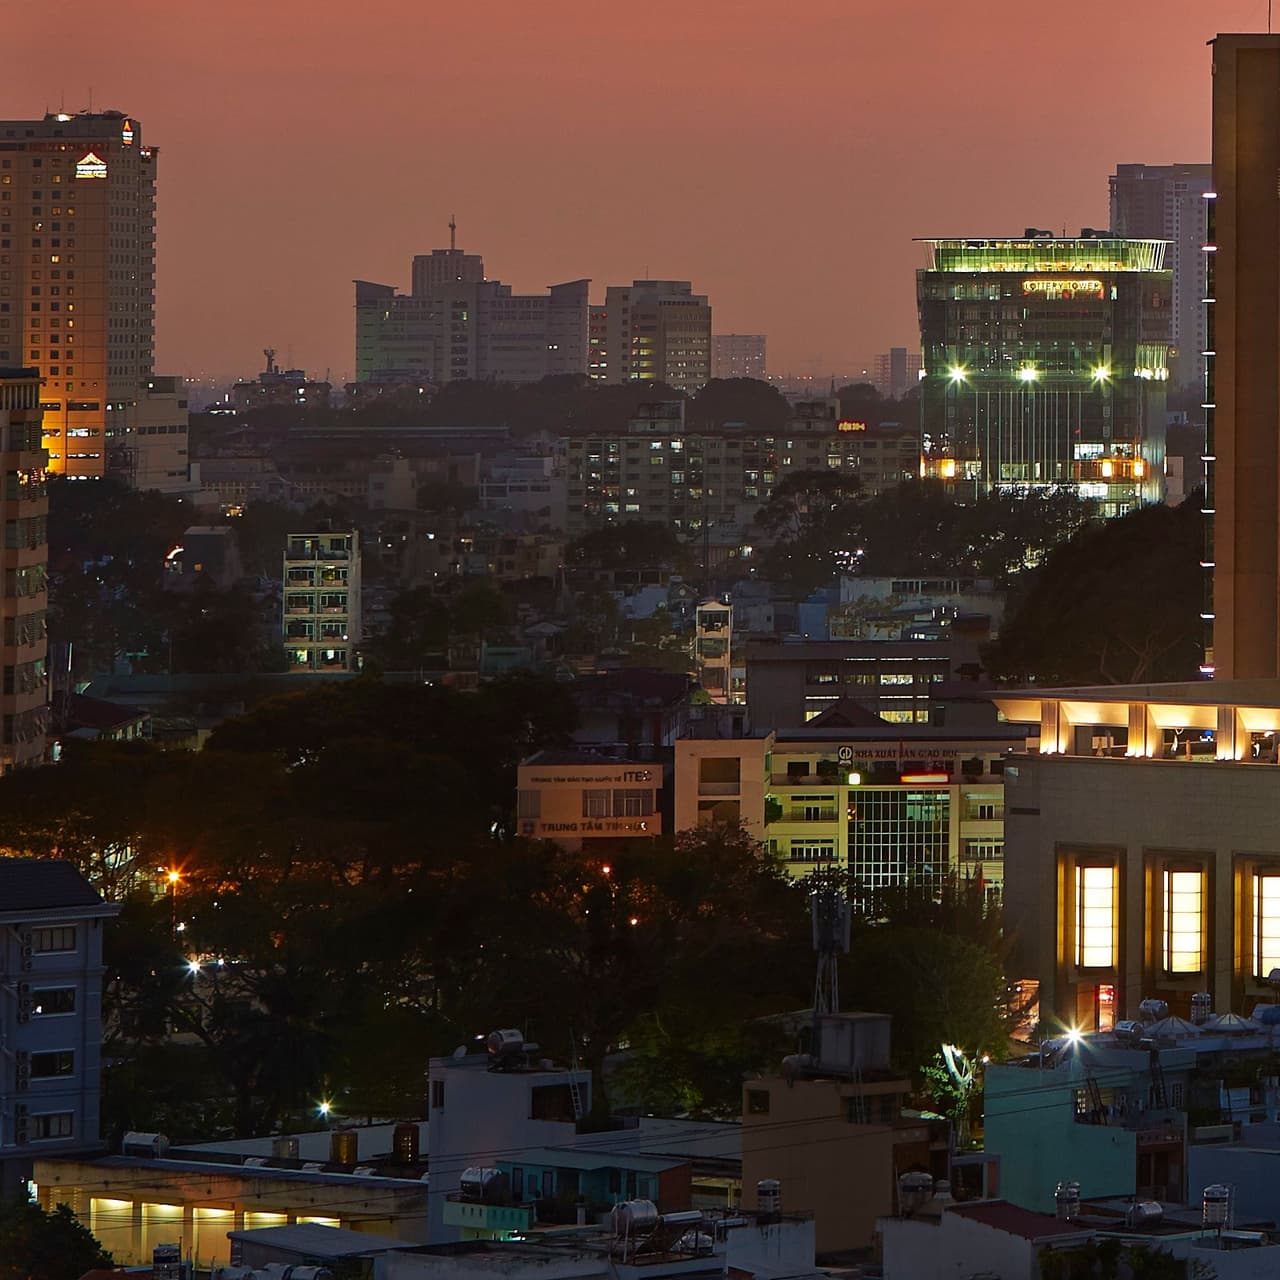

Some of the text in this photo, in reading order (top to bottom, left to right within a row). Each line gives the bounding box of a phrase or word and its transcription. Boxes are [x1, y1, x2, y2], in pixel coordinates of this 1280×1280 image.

[1024, 281, 1101, 290] LOTTERY TOWER
[541, 823, 577, 832] TRUNG
